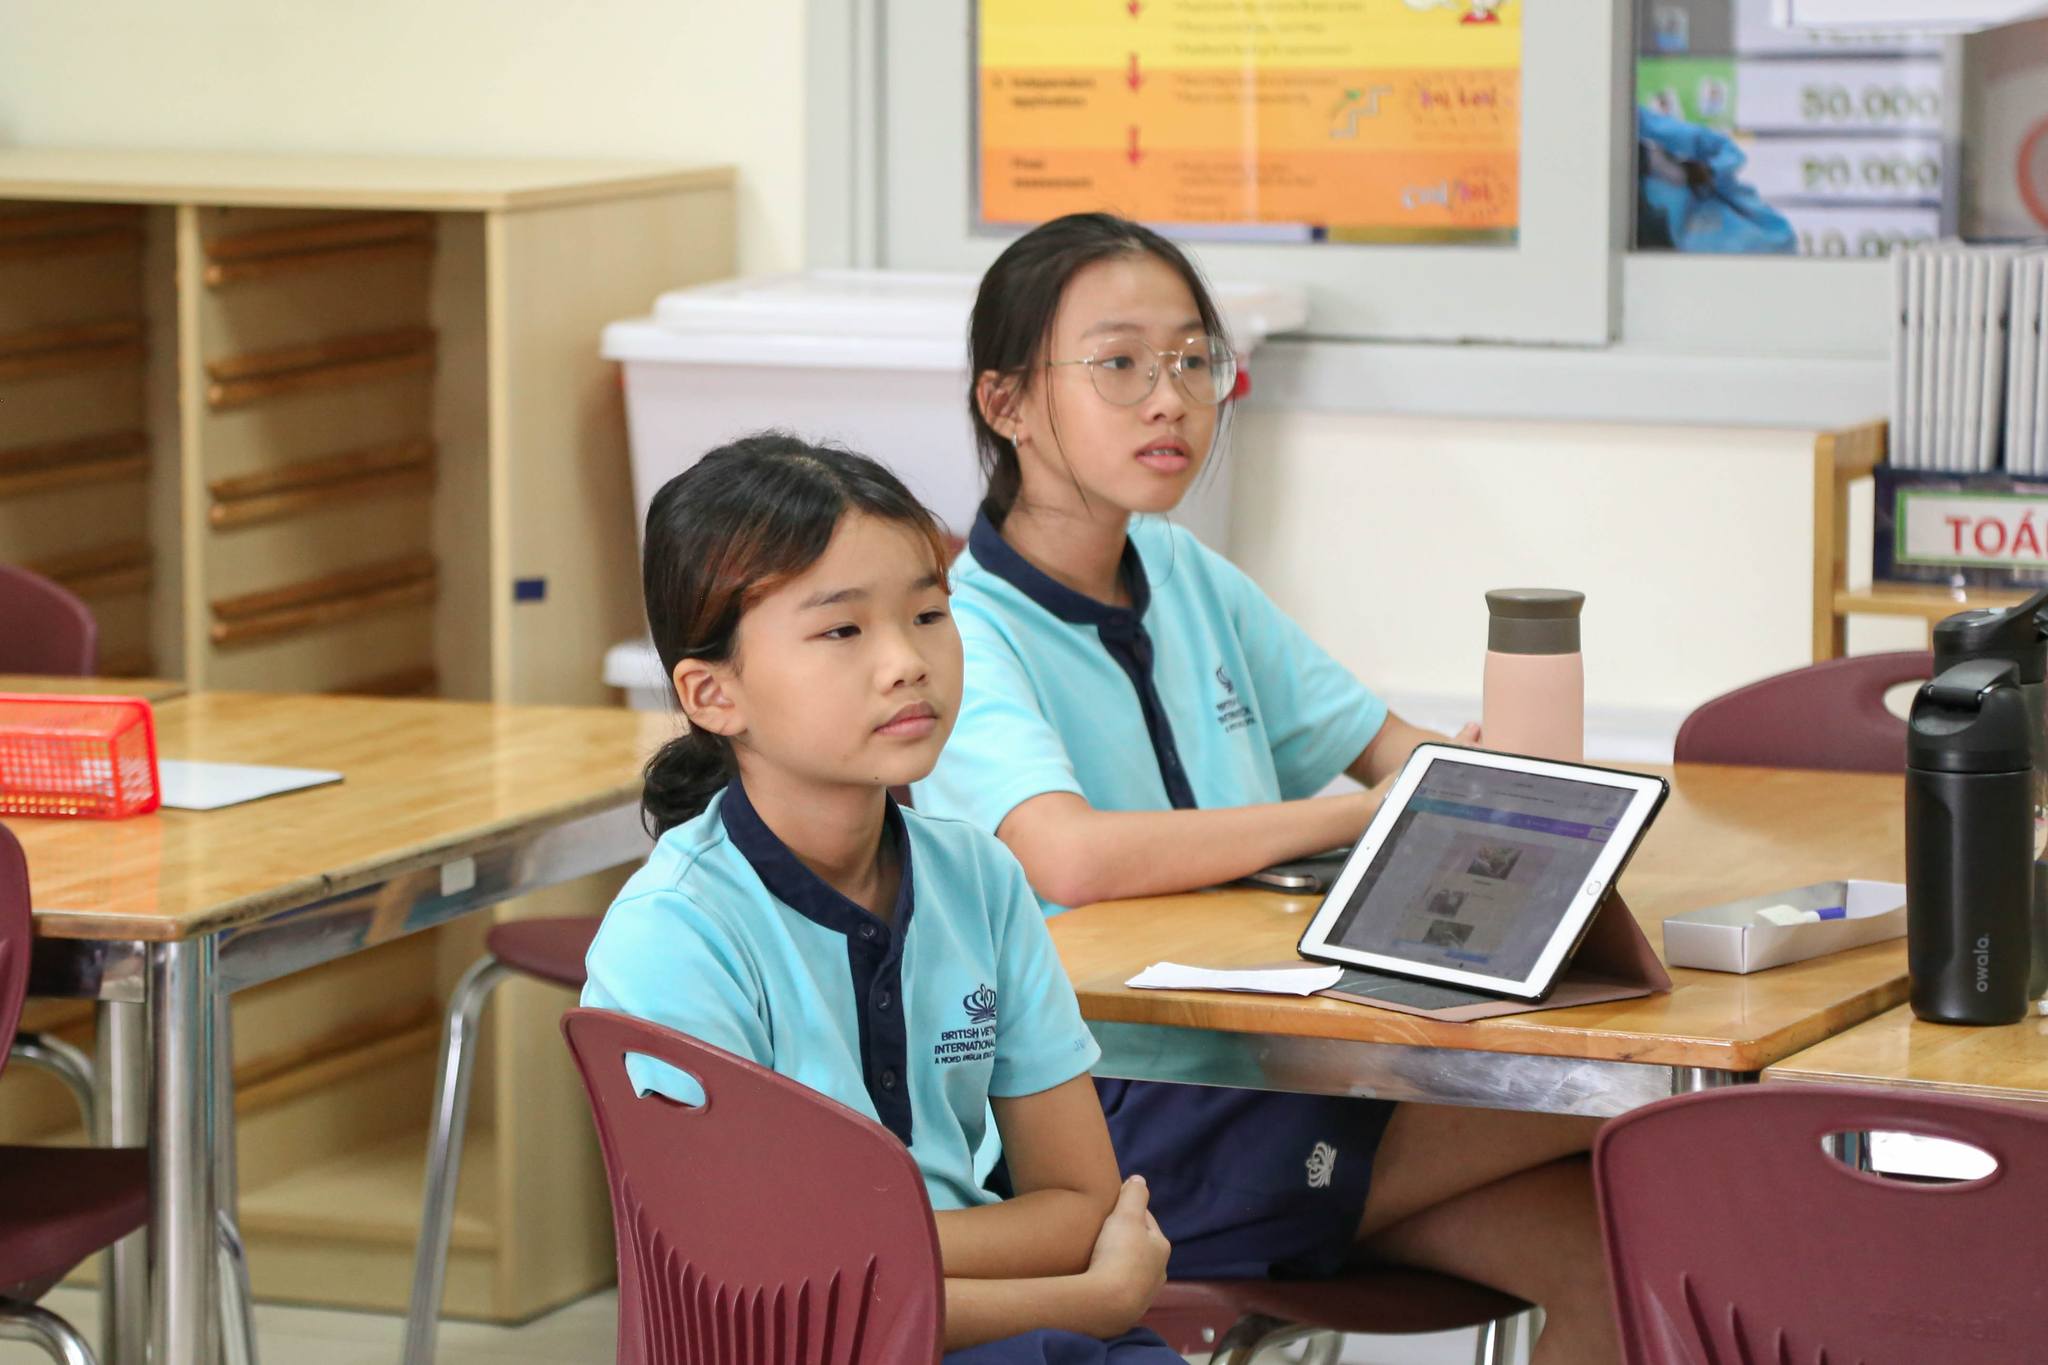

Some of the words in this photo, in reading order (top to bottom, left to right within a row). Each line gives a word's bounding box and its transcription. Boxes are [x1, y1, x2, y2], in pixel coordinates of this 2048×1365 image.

[1945, 509, 2048, 559] TOÁ
[1973, 937, 1989, 993] owala
[941, 1027, 979, 1041] BRITISH
